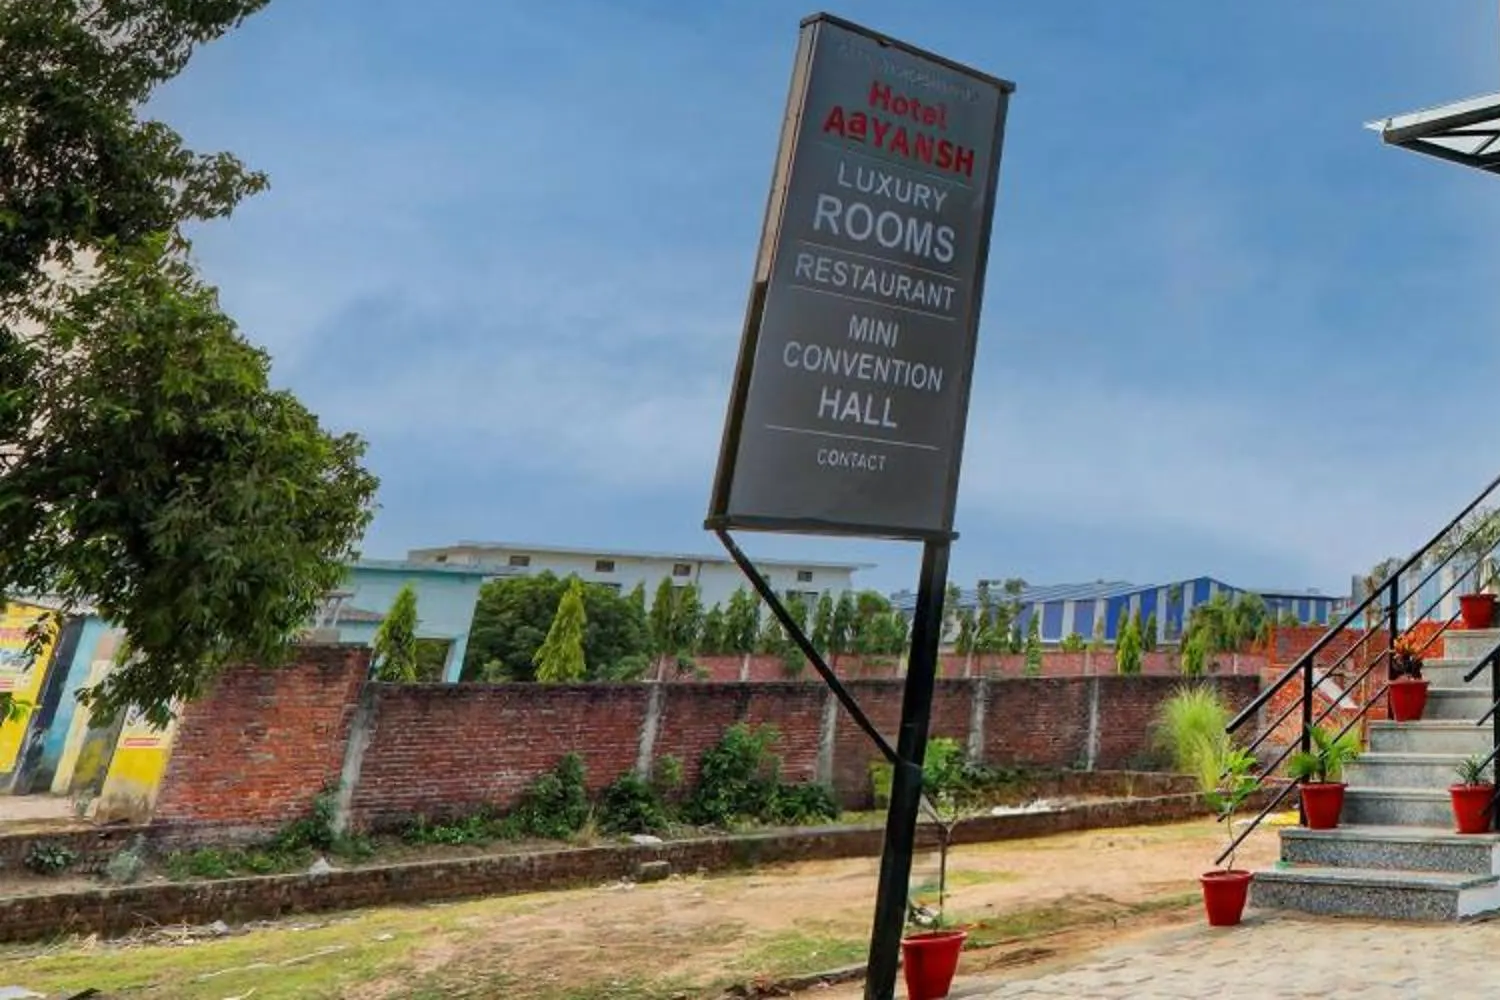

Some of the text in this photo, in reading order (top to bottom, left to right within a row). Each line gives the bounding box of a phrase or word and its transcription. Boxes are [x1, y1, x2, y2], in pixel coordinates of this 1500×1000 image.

[868, 80, 947, 131] Hotel
[823, 105, 975, 178] AaYANSH
[837, 161, 948, 213] LUXURY
[813, 193, 955, 262] ROOMS
[795, 253, 956, 311] RESTAURANT
[849, 314, 899, 348] MINI
[783, 341, 943, 393] CONVENTION
[817, 386, 897, 428] HALL
[817, 448, 887, 471] CONTACT
